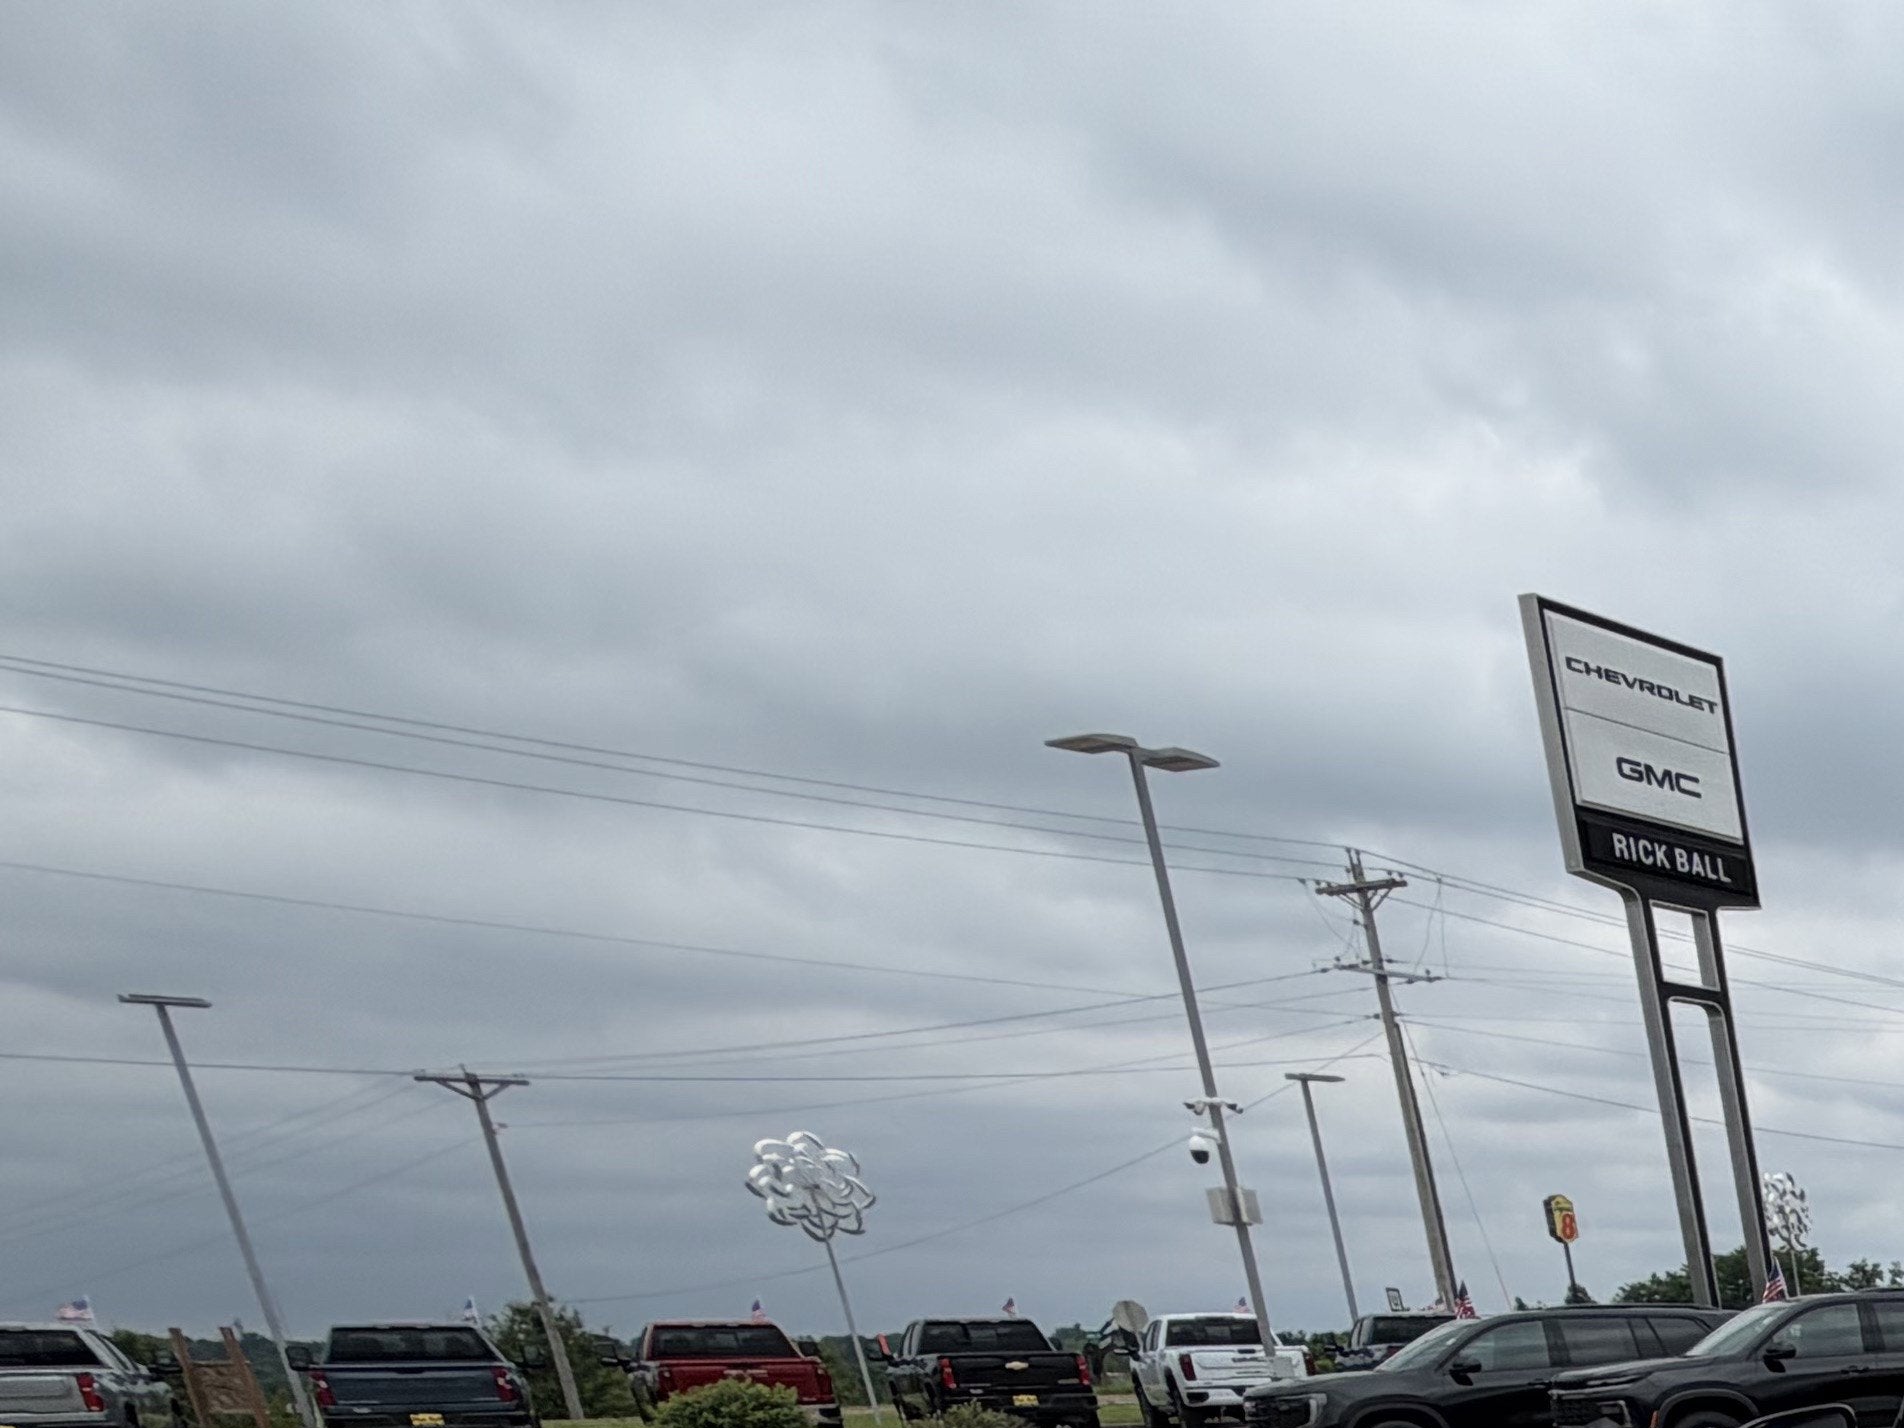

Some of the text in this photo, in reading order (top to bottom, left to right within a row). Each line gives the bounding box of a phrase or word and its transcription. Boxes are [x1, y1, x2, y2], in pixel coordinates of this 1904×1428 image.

[1565, 656, 1718, 714] CHEVROLET
[1616, 757, 1702, 798] GMC
[1612, 832, 1732, 883] RICK BALL
